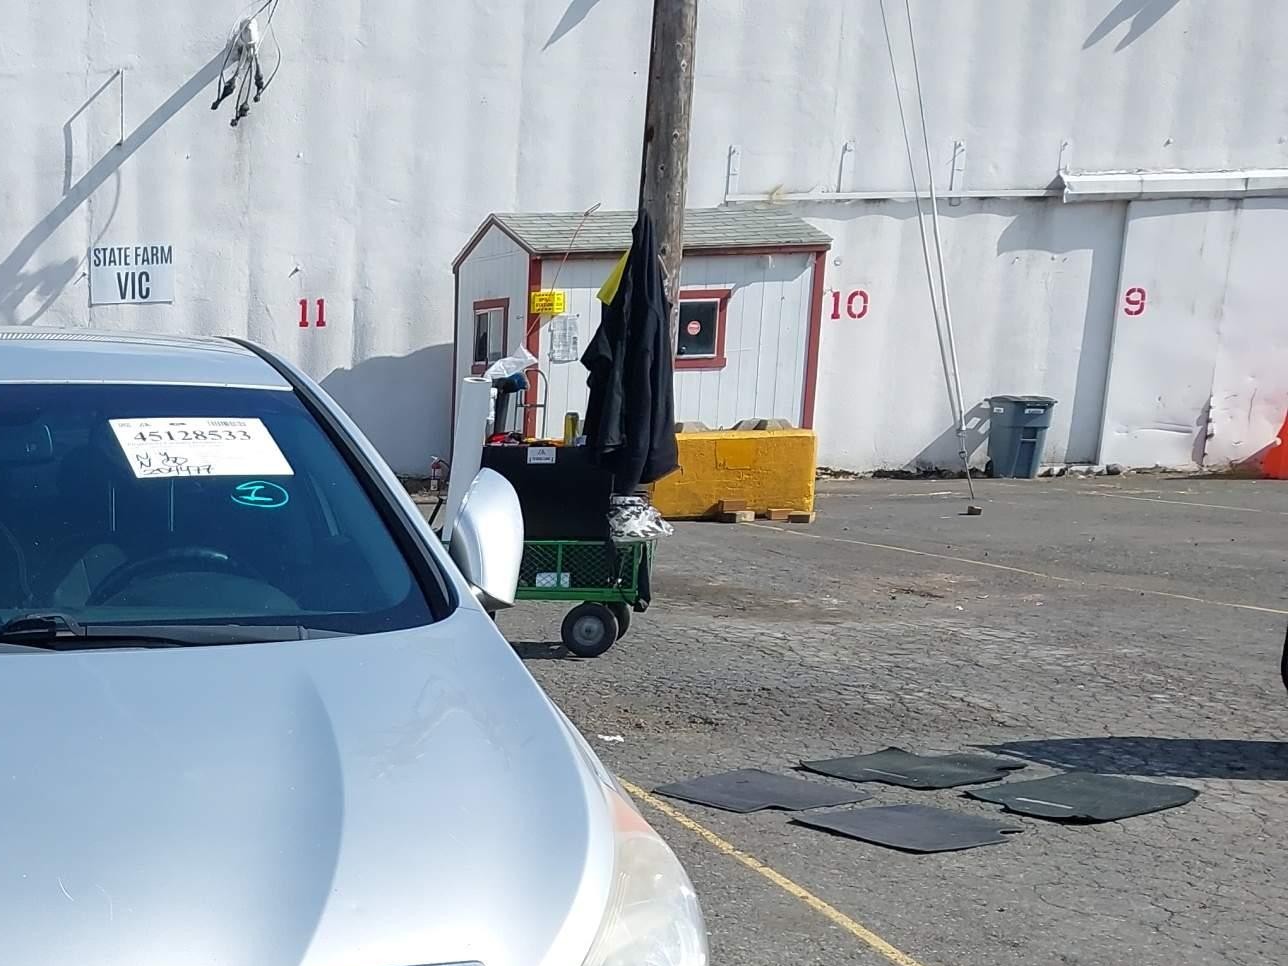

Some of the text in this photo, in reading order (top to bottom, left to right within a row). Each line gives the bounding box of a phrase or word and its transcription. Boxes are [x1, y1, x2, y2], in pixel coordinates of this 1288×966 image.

[93, 245, 173, 267] STATE FARM
[117, 271, 151, 300] VIC
[299, 298, 326, 327] 11
[830, 290, 869, 319] 10
[1123, 287, 1147, 316] 9
[134, 430, 251, 441] 45128533
